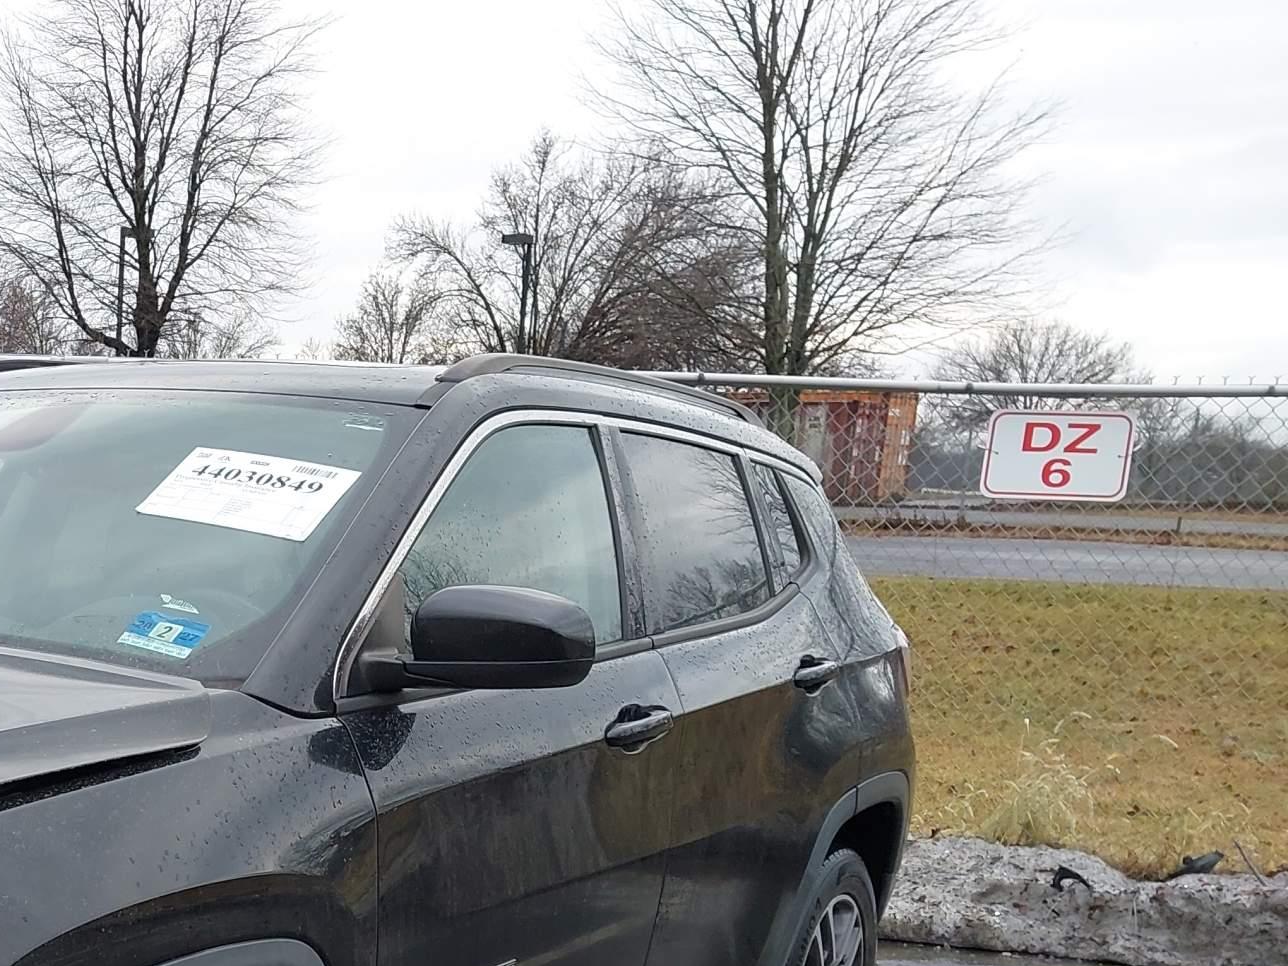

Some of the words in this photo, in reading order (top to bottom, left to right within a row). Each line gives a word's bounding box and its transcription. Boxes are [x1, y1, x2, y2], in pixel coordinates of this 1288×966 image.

[1021, 422, 1103, 454] DZ
[192, 464, 324, 494] 44030849
[1041, 458, 1073, 488] 6
[157, 625, 174, 639] 2
